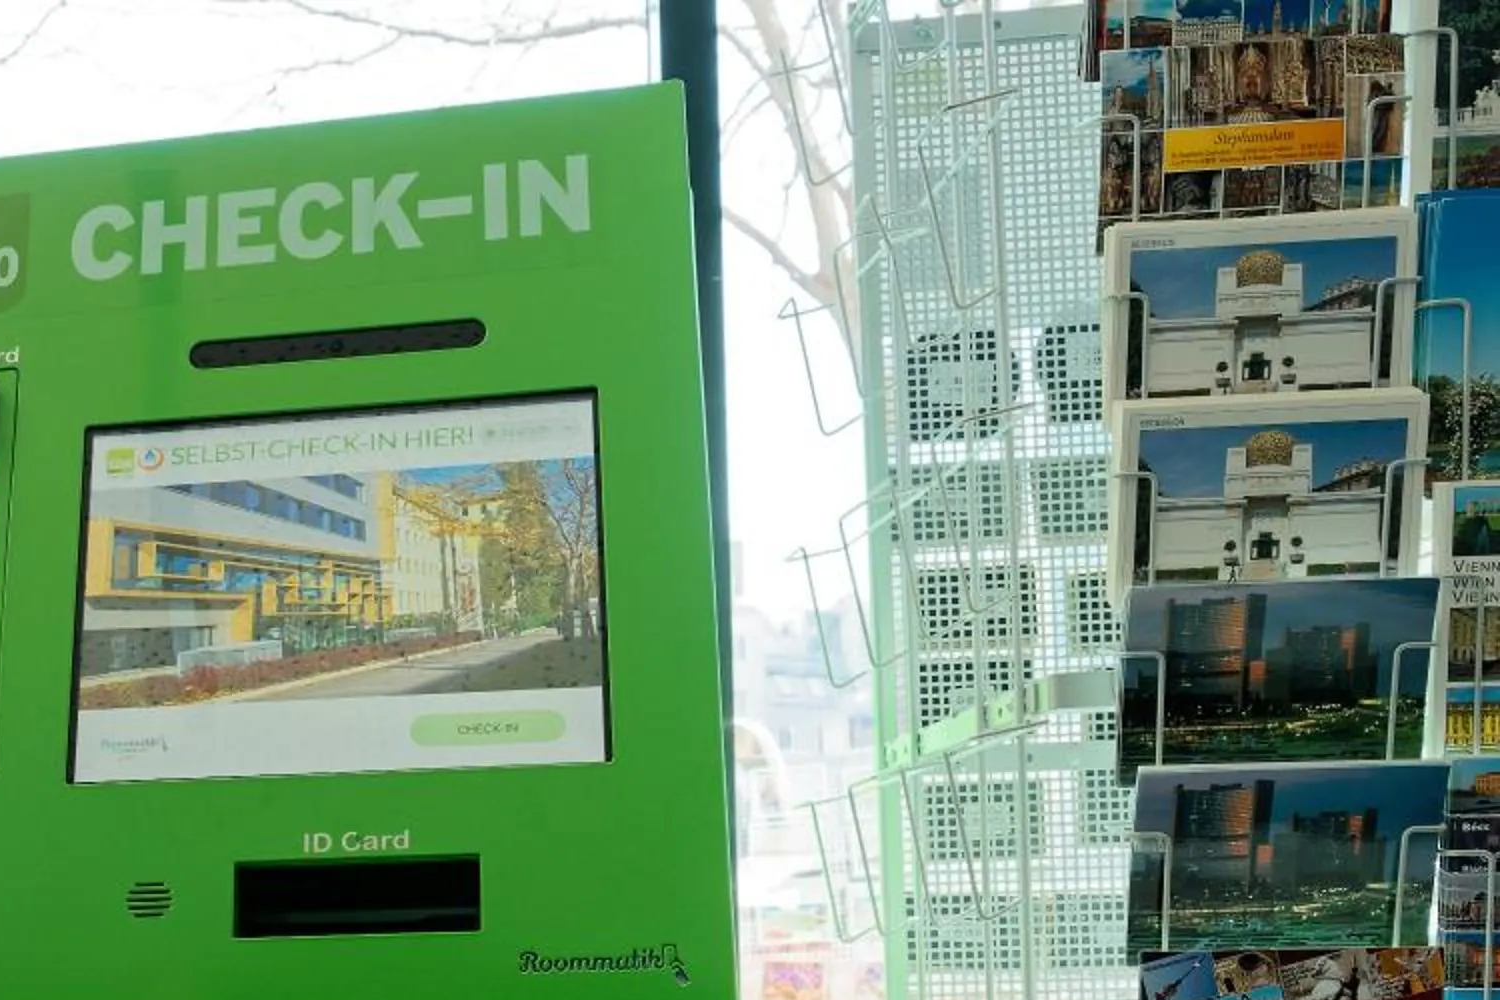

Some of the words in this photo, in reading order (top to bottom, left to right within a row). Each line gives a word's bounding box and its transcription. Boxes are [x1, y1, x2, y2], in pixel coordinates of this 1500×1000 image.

[71, 154, 591, 282] CHECK-IN
[171, 430, 398, 466] SELBST-CHECK-IN
[405, 424, 473, 449] HIER!
[1453, 559, 1500, 573] VIENN
[303, 832, 332, 853] ID
[341, 830, 410, 852] Card
[519, 948, 665, 974] Roommatik
